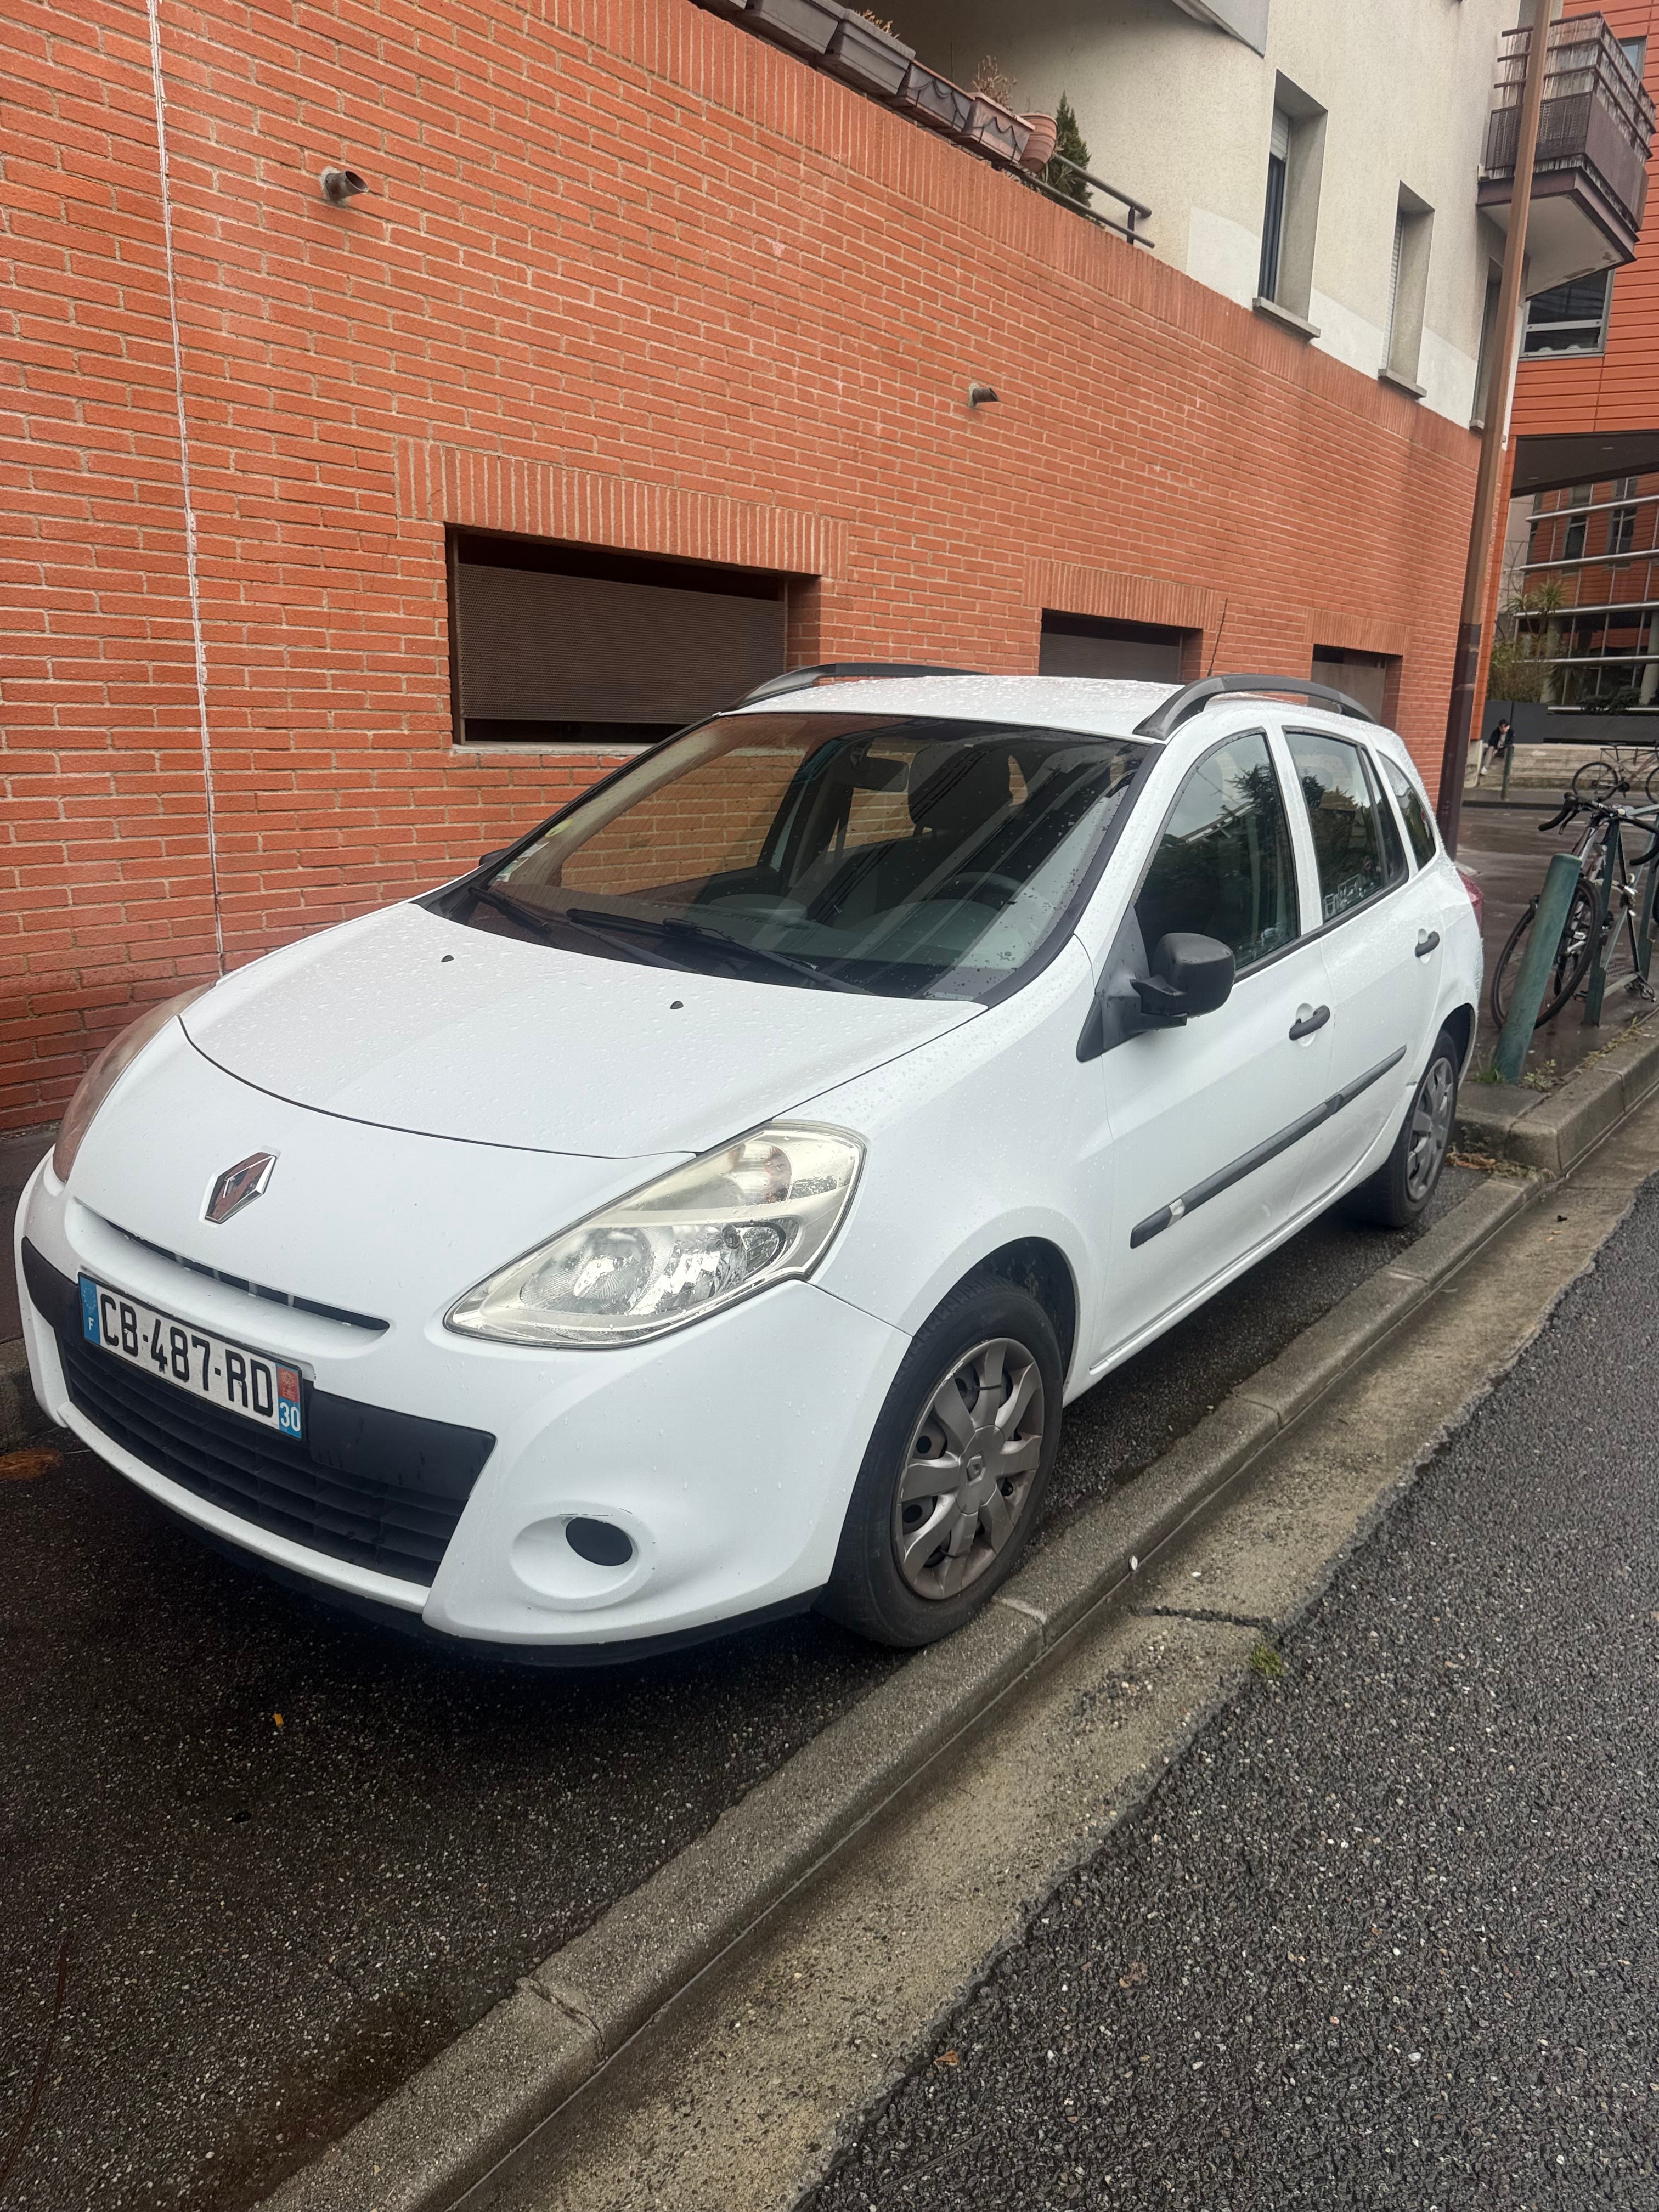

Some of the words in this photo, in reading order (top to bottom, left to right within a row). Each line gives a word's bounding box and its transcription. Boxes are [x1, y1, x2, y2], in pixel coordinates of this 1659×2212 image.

[88, 1317, 94, 1330] F
[100, 1294, 274, 1418] CB-487-RD
[280, 1402, 301, 1432] 30
